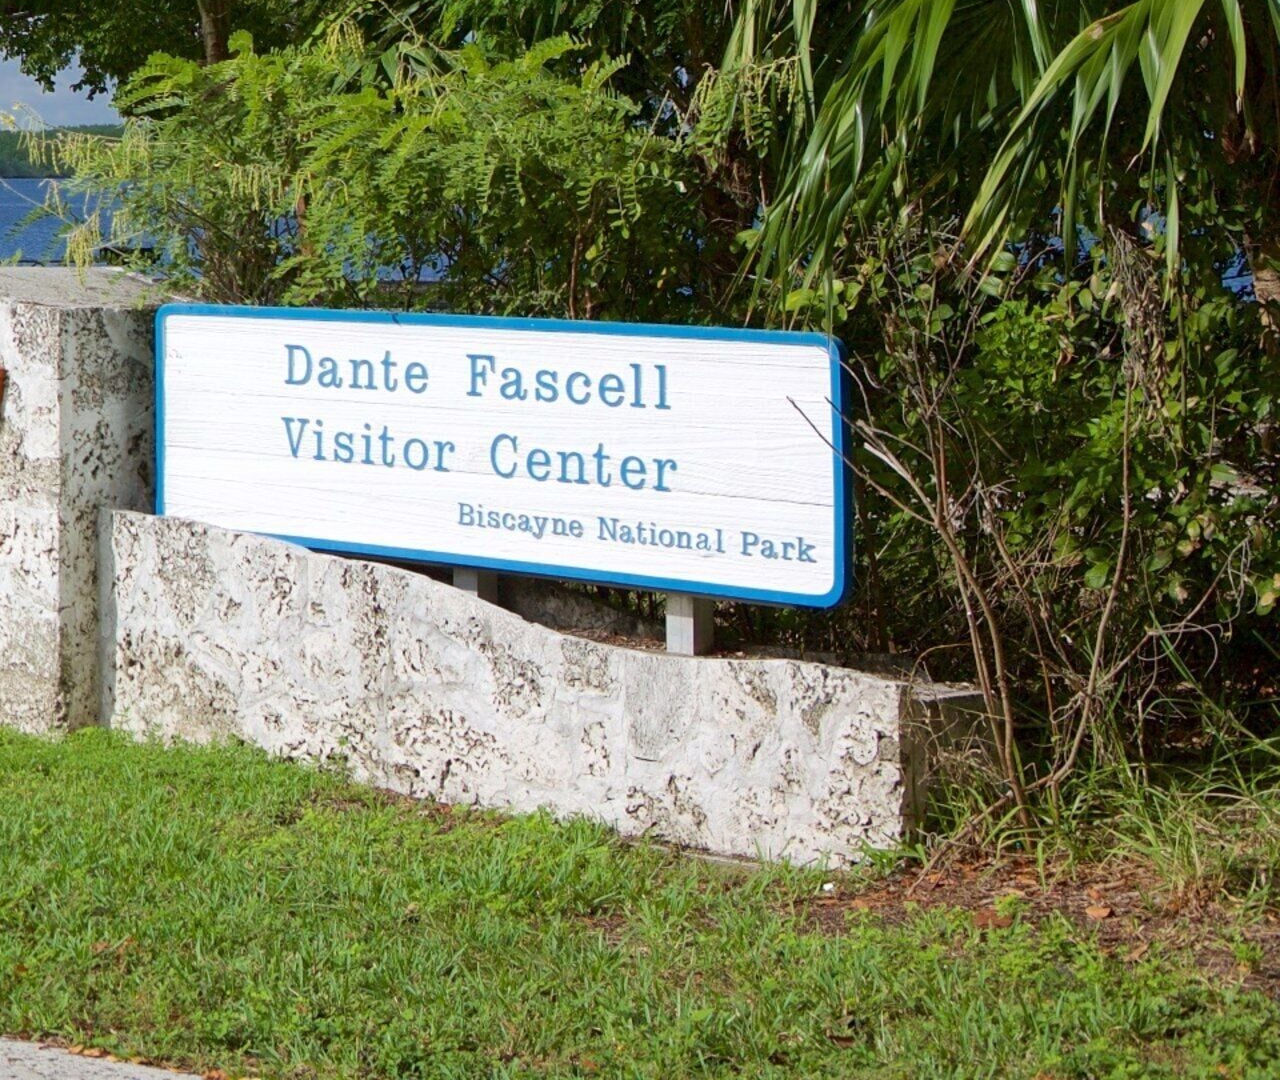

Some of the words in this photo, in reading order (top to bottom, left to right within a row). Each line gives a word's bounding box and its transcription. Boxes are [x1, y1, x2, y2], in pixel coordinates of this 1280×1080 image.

[285, 344, 429, 394] Dante
[466, 353, 672, 410] Fascell
[282, 416, 456, 472] Visitor
[489, 432, 679, 493] Center
[457, 503, 584, 539] Biscayne
[597, 516, 726, 554] National
[741, 531, 817, 564] Park
